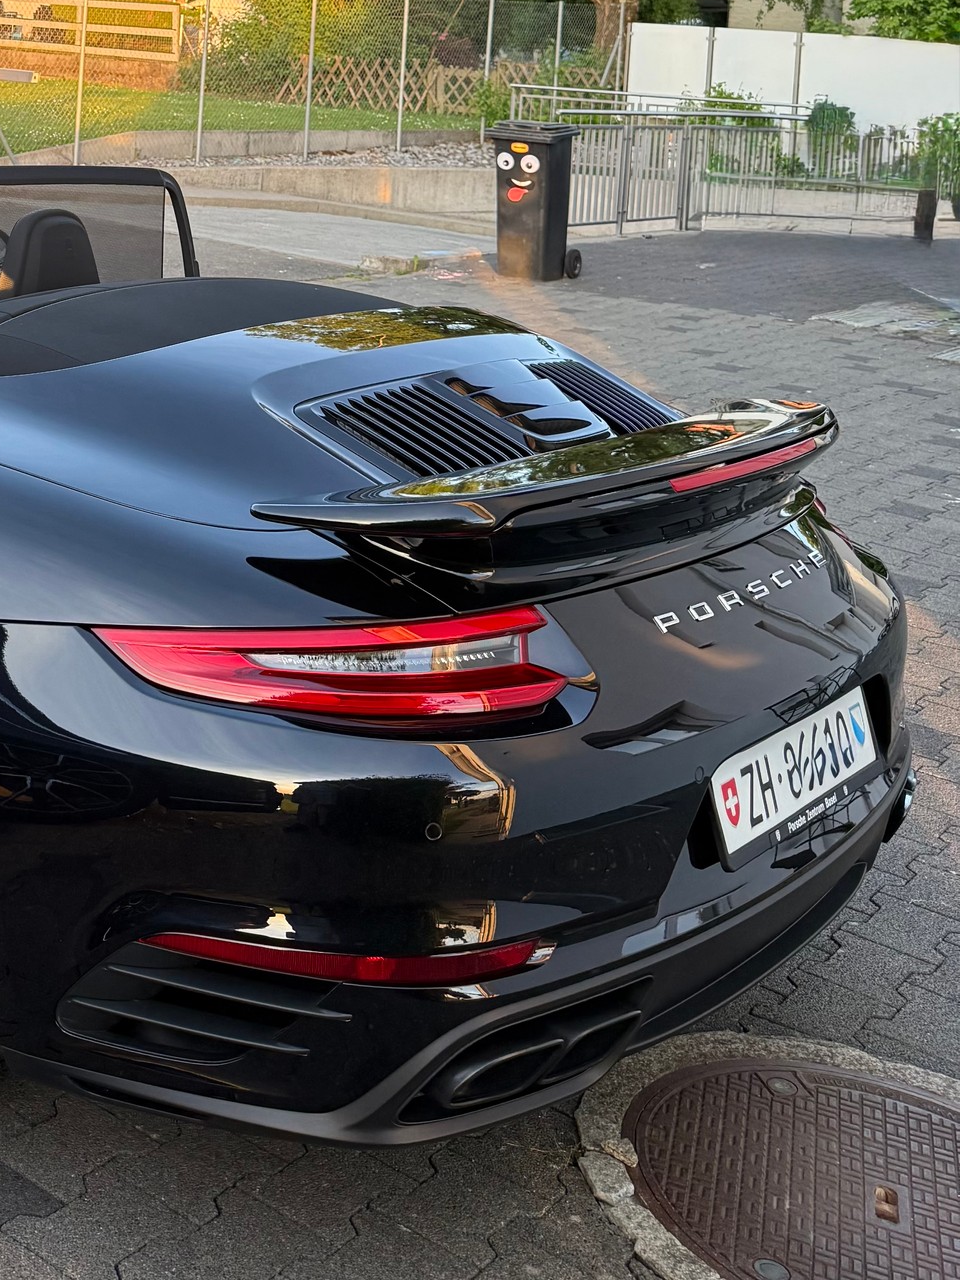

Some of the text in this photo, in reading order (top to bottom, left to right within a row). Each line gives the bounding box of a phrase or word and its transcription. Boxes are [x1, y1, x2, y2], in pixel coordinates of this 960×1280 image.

[653, 549, 827, 634] PORSCHE
[787, 792, 838, 834] Porsche Zentrum Basel
